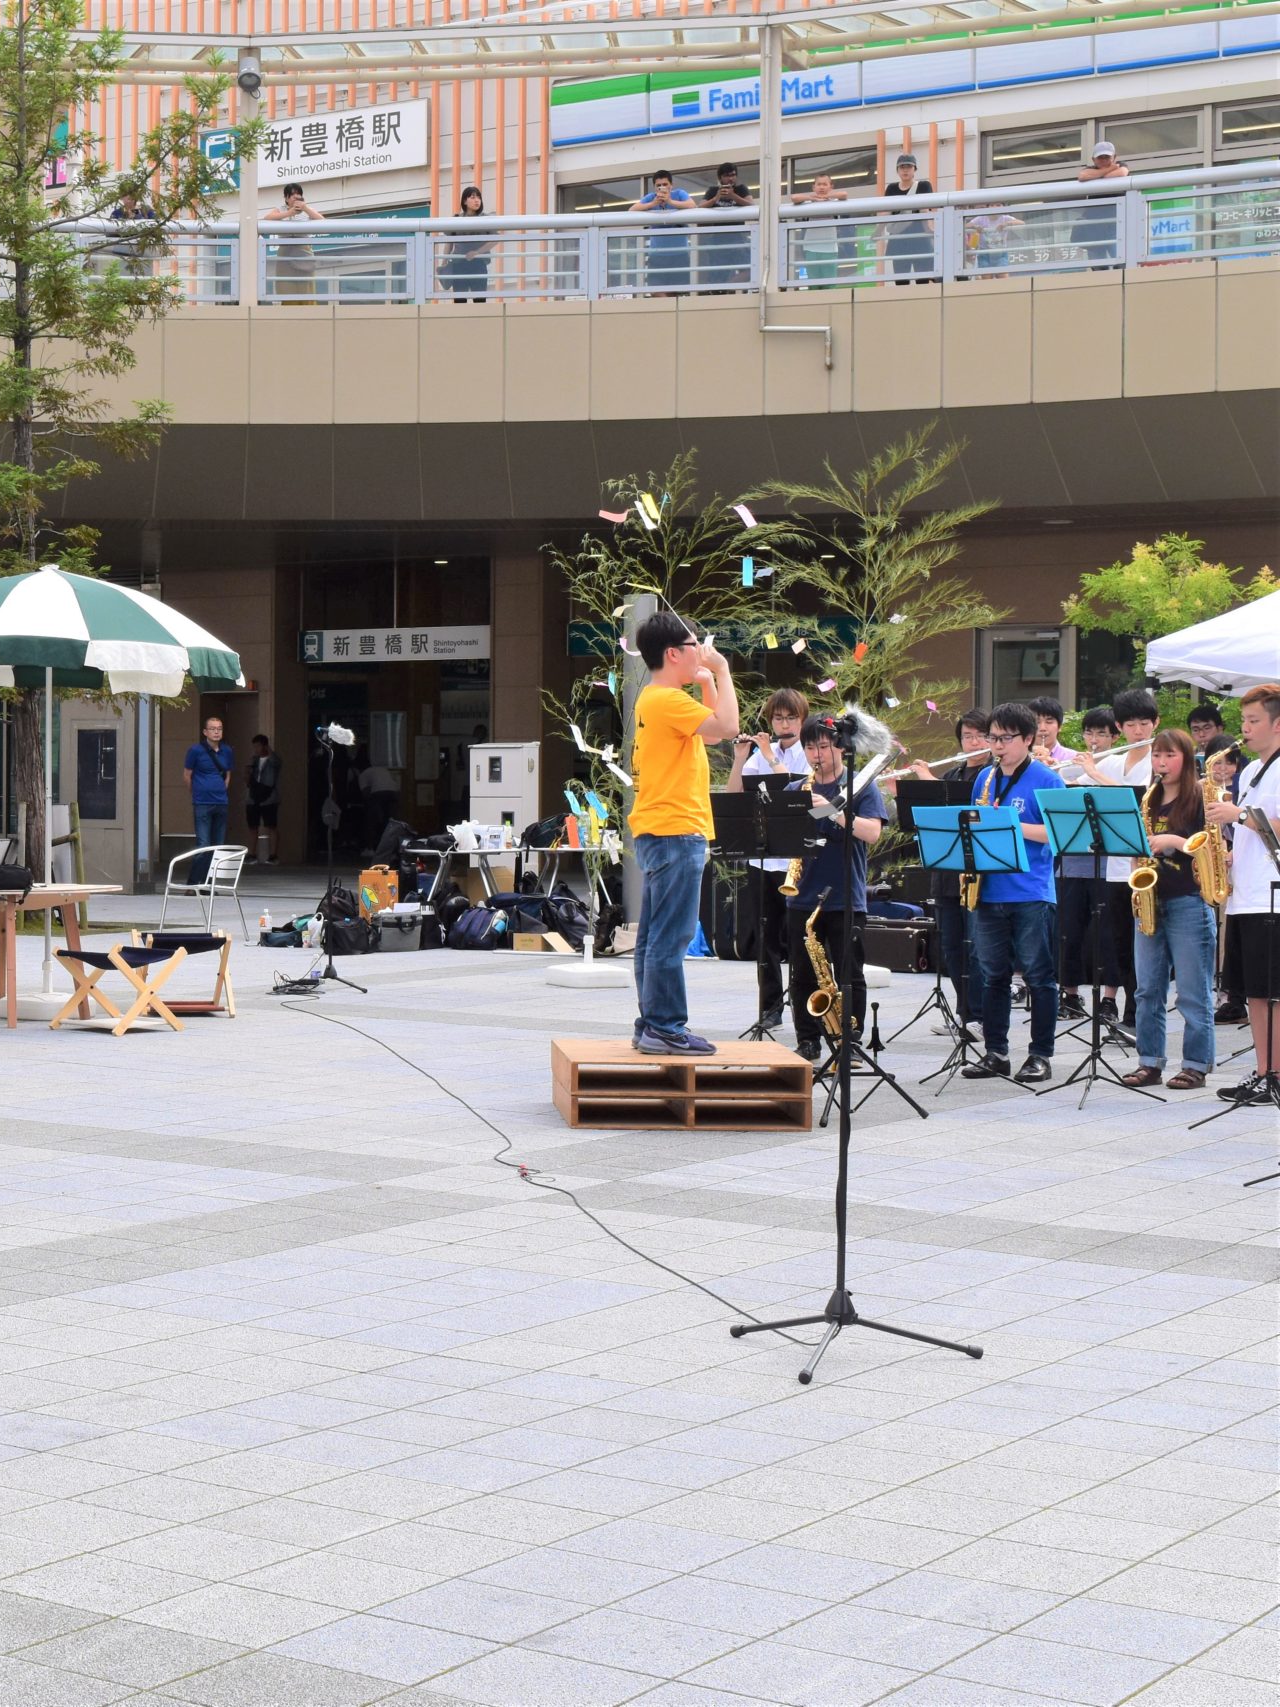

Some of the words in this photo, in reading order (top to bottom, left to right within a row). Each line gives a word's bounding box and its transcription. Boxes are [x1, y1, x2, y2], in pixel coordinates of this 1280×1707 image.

[708, 74, 834, 113] FamiMart
[264, 111, 402, 164] 新豊橋駅
[276, 158, 352, 179] Shintoyohashi
[353, 152, 393, 168] Station
[332, 633, 429, 657] 新豊橋駅
[433, 638, 479, 648] Shintoyohashi
[433, 646, 456, 654] Station
